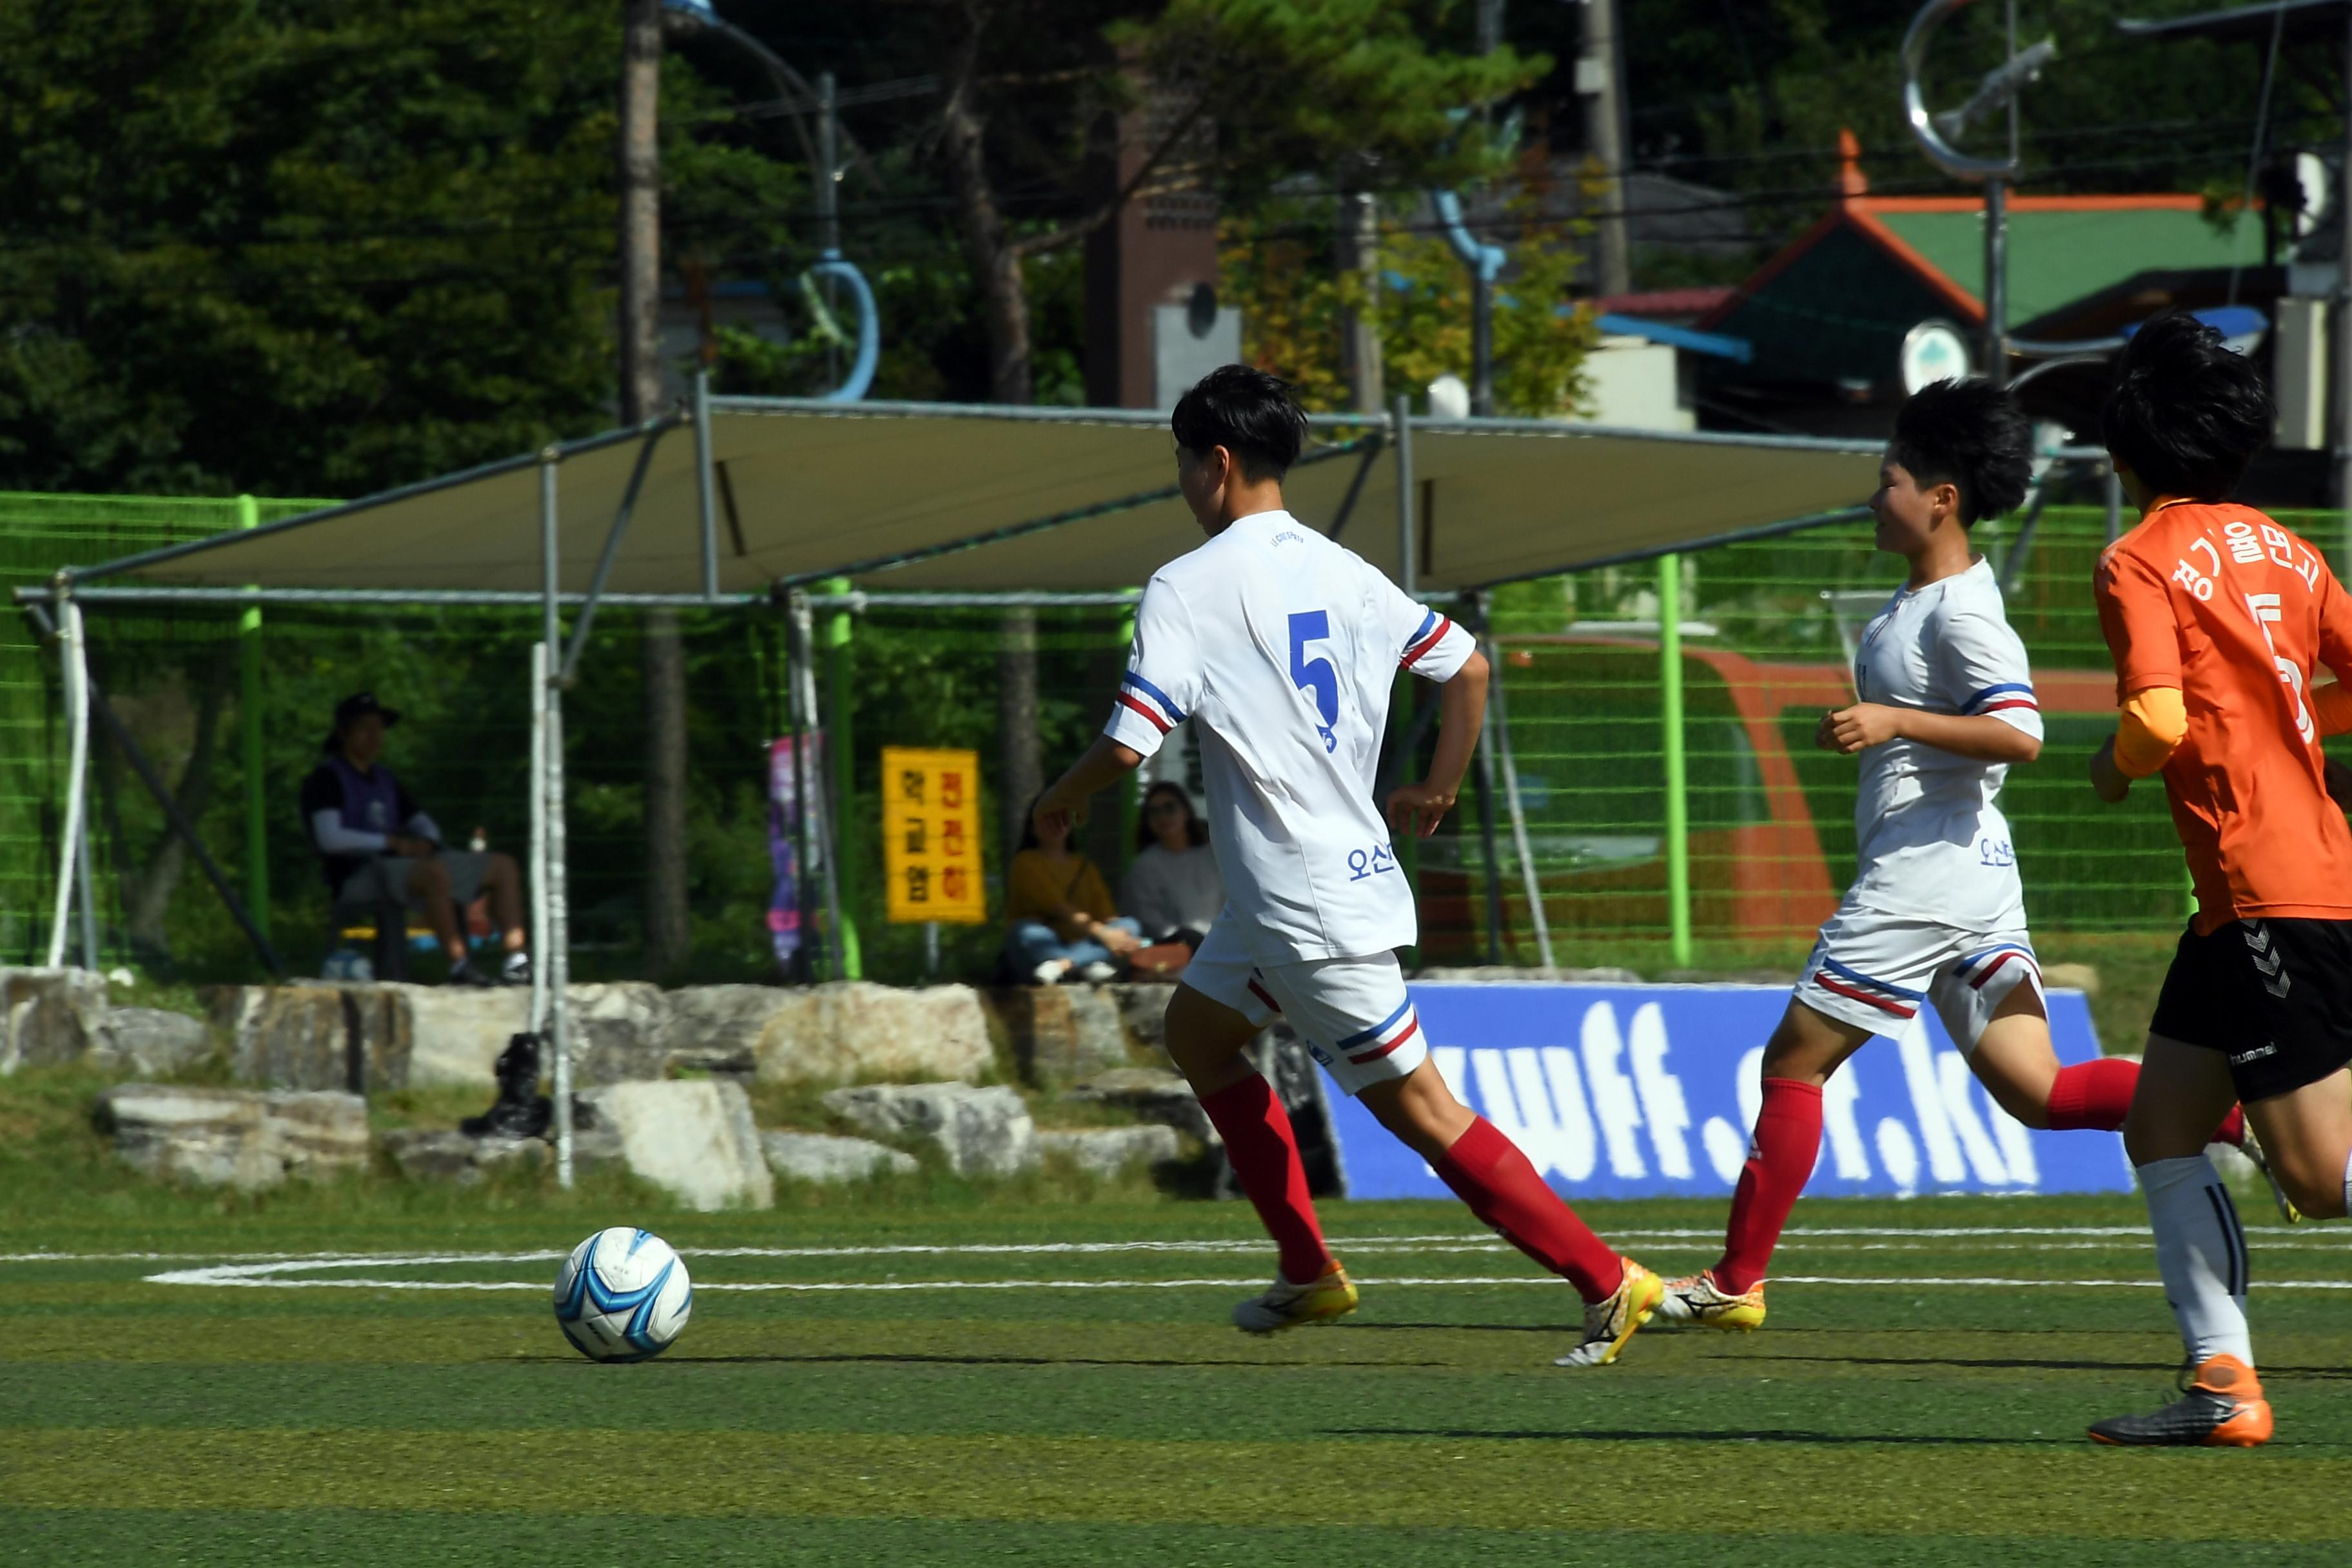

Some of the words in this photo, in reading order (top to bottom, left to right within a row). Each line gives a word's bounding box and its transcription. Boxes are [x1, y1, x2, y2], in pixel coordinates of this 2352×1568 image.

[1288, 609, 1339, 728] 5
[1348, 842, 1395, 882] 오산
[2230, 1041, 2278, 1067] hummel
